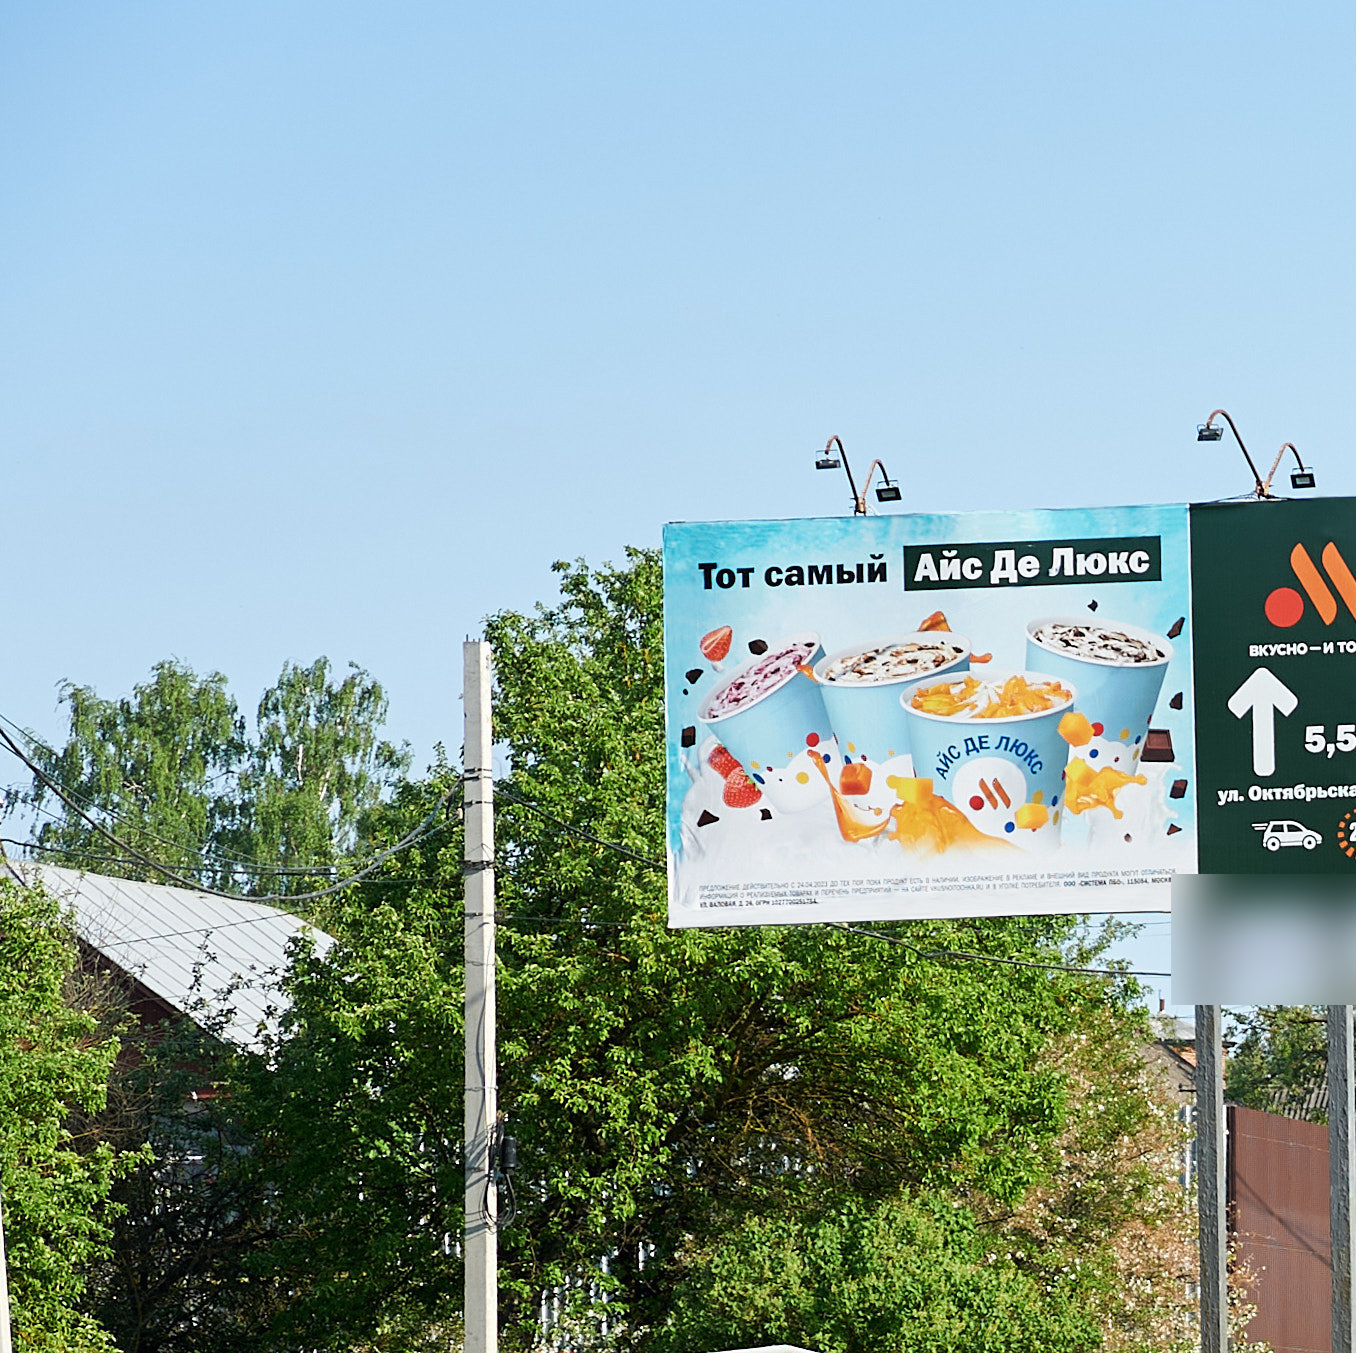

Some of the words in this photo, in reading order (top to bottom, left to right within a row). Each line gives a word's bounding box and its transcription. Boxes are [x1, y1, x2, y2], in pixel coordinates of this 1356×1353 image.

[698, 562, 754, 590] Тот
[764, 554, 889, 588] самый
[913, 549, 983, 583] Айс
[989, 549, 1042, 584] Де
[1048, 547, 1151, 577] Люкс
[1249, 642, 1308, 657] ВКУСНО
[936, 745, 961, 780] АЙС
[963, 735, 990, 756] ДЕ
[995, 736, 1043, 775] ЛЮКС
[1217, 789, 1245, 805] ул.
[1151, 876, 1171, 884] МОСКВ
